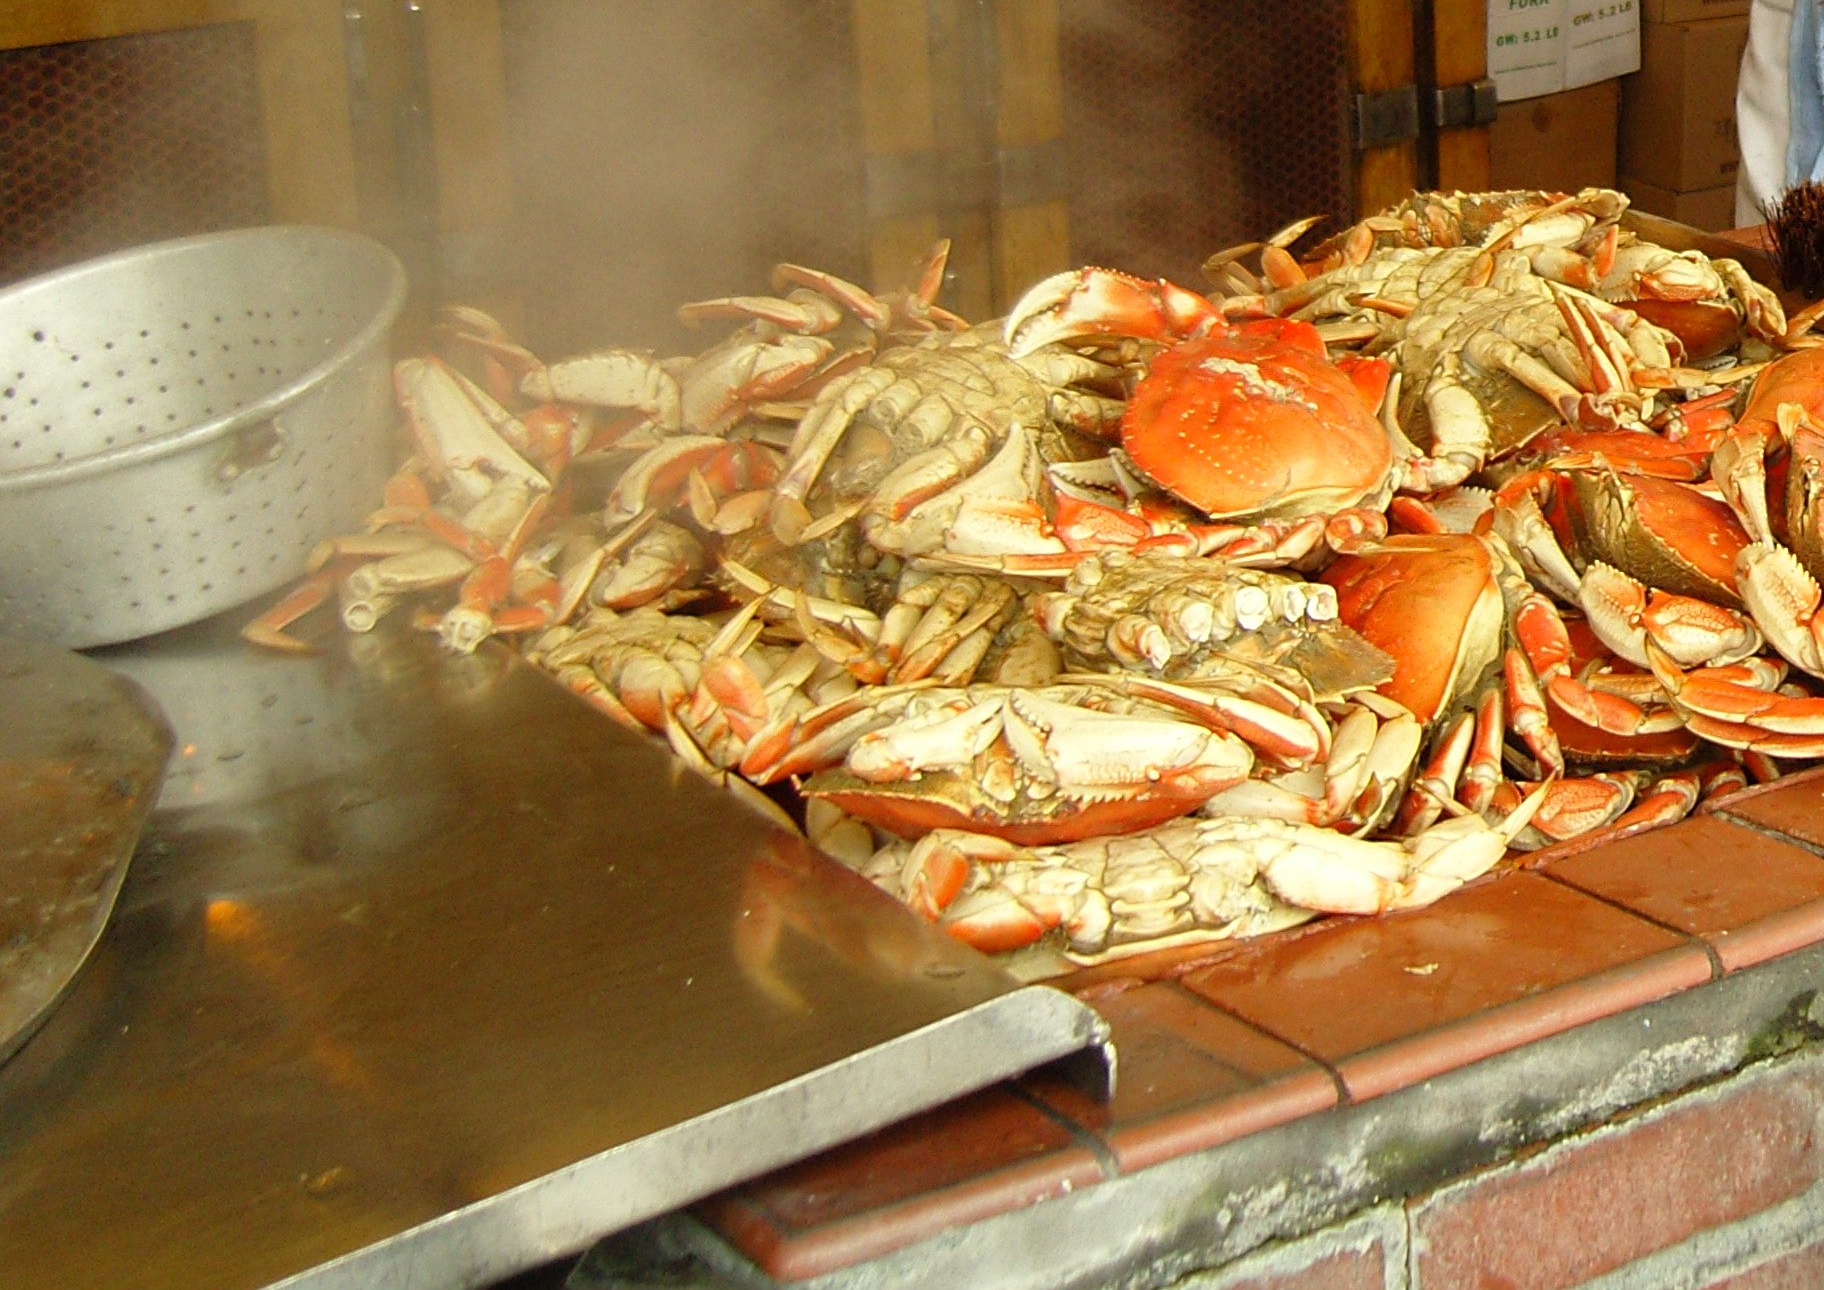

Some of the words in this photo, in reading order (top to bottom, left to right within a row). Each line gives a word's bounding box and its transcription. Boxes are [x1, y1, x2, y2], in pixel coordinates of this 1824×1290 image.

[1572, 13, 1595, 27] GW:
[1598, 6, 1616, 19] 5.2
[1619, 0, 1633, 14] LB
[1495, 35, 1518, 48] GW:
[1523, 29, 1541, 43] 5.2
[1546, 26, 1560, 39] LB
